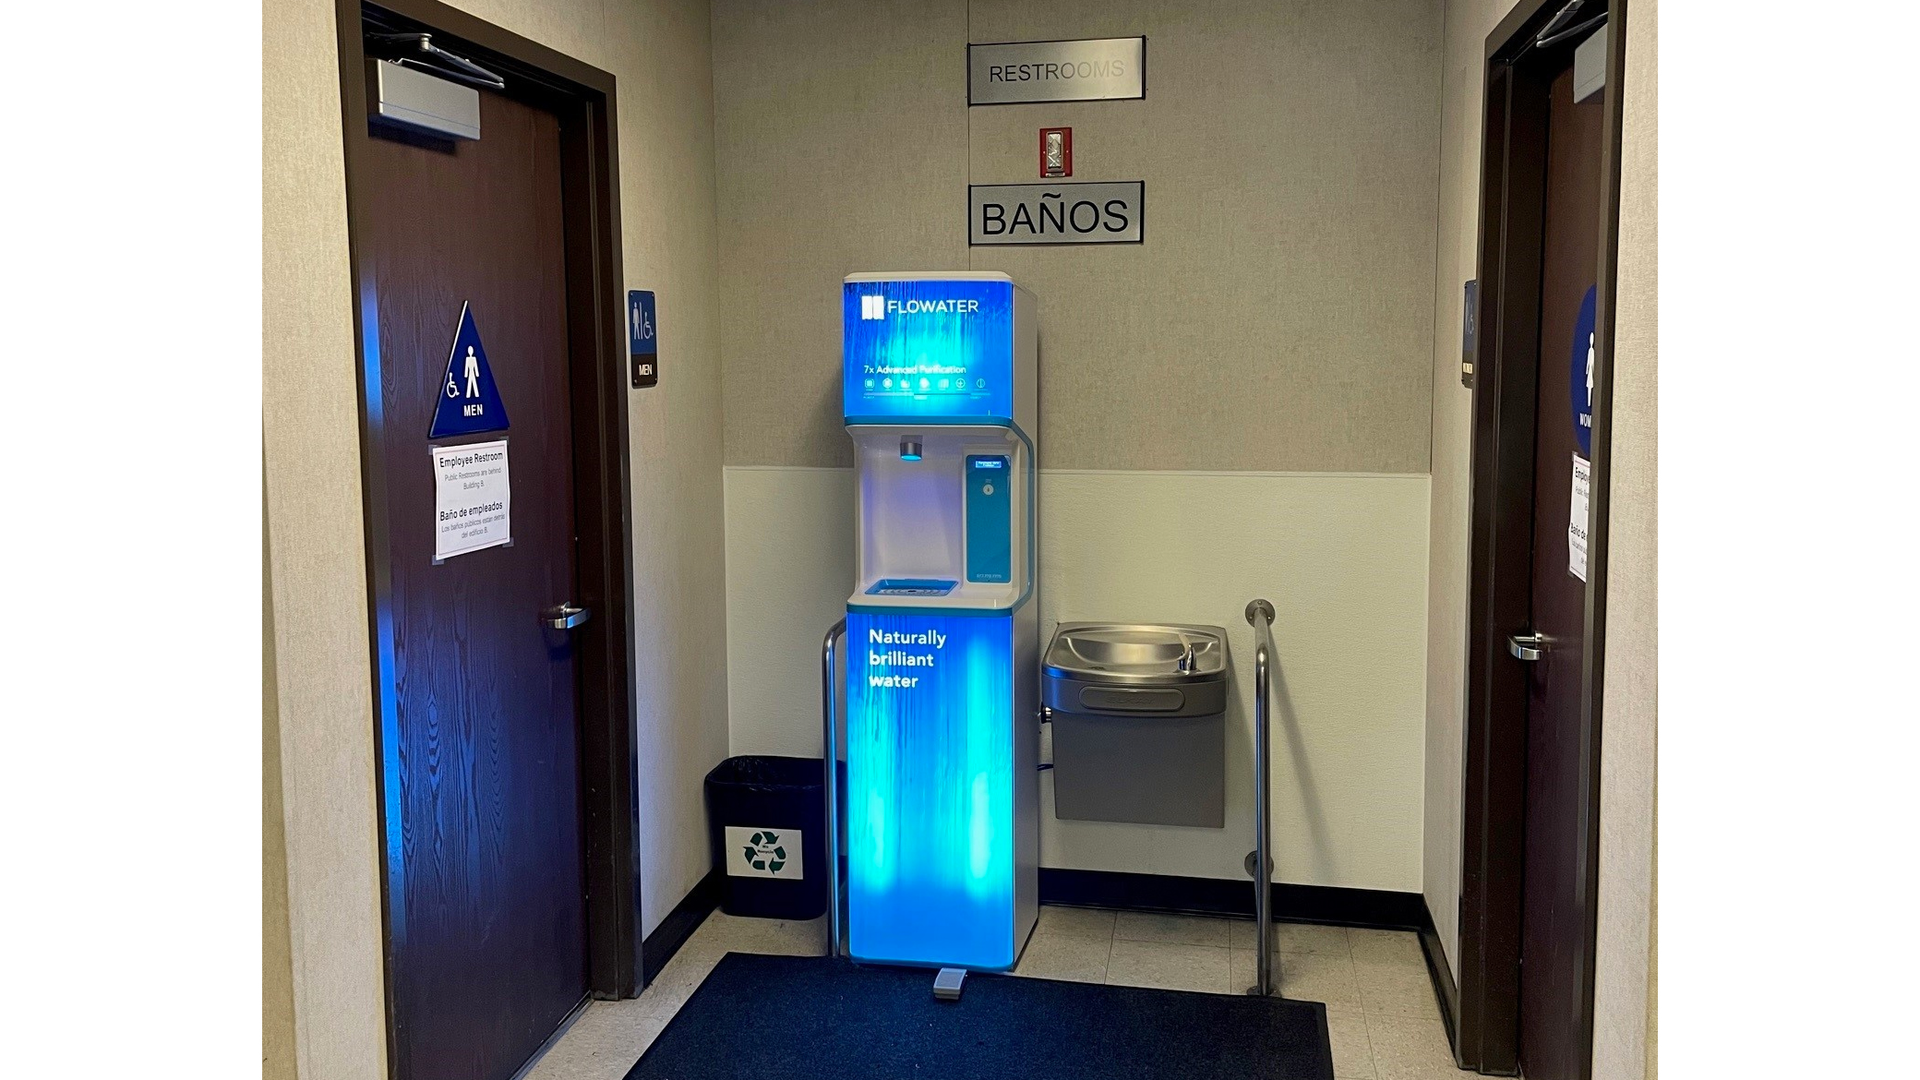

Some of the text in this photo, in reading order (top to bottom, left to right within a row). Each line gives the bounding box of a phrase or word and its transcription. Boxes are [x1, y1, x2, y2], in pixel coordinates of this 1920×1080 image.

[990, 60, 1125, 83] RESTROOMS
[982, 192, 1129, 235] BAÑOS
[887, 299, 979, 314] FLOWATER
[639, 364, 653, 376] MEN
[864, 365, 874, 374] 7x
[876, 365, 918, 375] Advanced
[463, 404, 483, 417] MEN
[440, 452, 503, 468] Employee Restroom
[445, 473, 458, 482] Public
[440, 501, 503, 522] Baño de empleados
[869, 628, 947, 649] Naturally
[869, 649, 934, 667] brilliant
[868, 675, 919, 688] water
